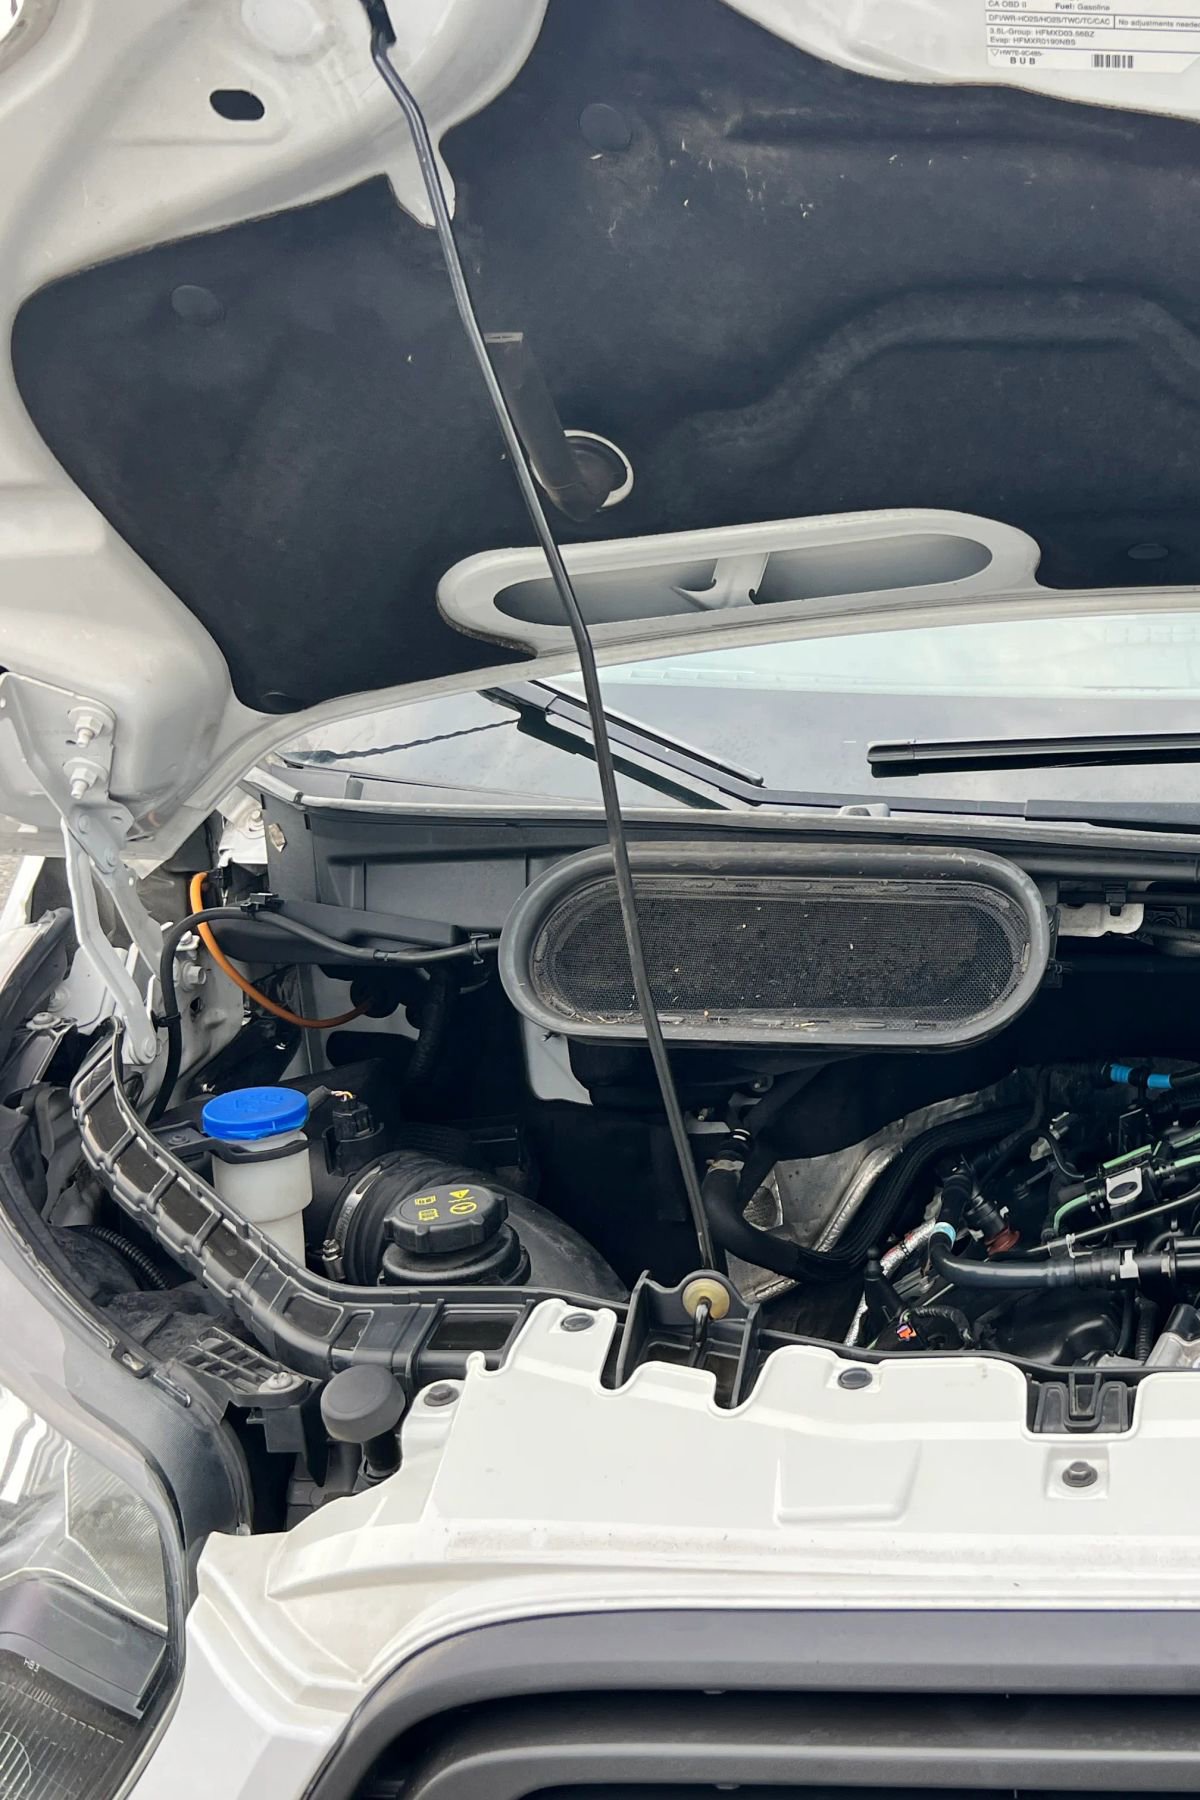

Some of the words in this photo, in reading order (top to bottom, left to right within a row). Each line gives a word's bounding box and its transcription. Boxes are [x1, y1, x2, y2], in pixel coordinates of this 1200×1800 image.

[1001, 0, 1020, 8] OBD
[1055, 2, 1074, 10] Fuel:
[1077, 3, 1111, 11] Gasoline
[1131, 19, 1174, 29] adjustments
[990, 36, 1010, 45] Evap:
